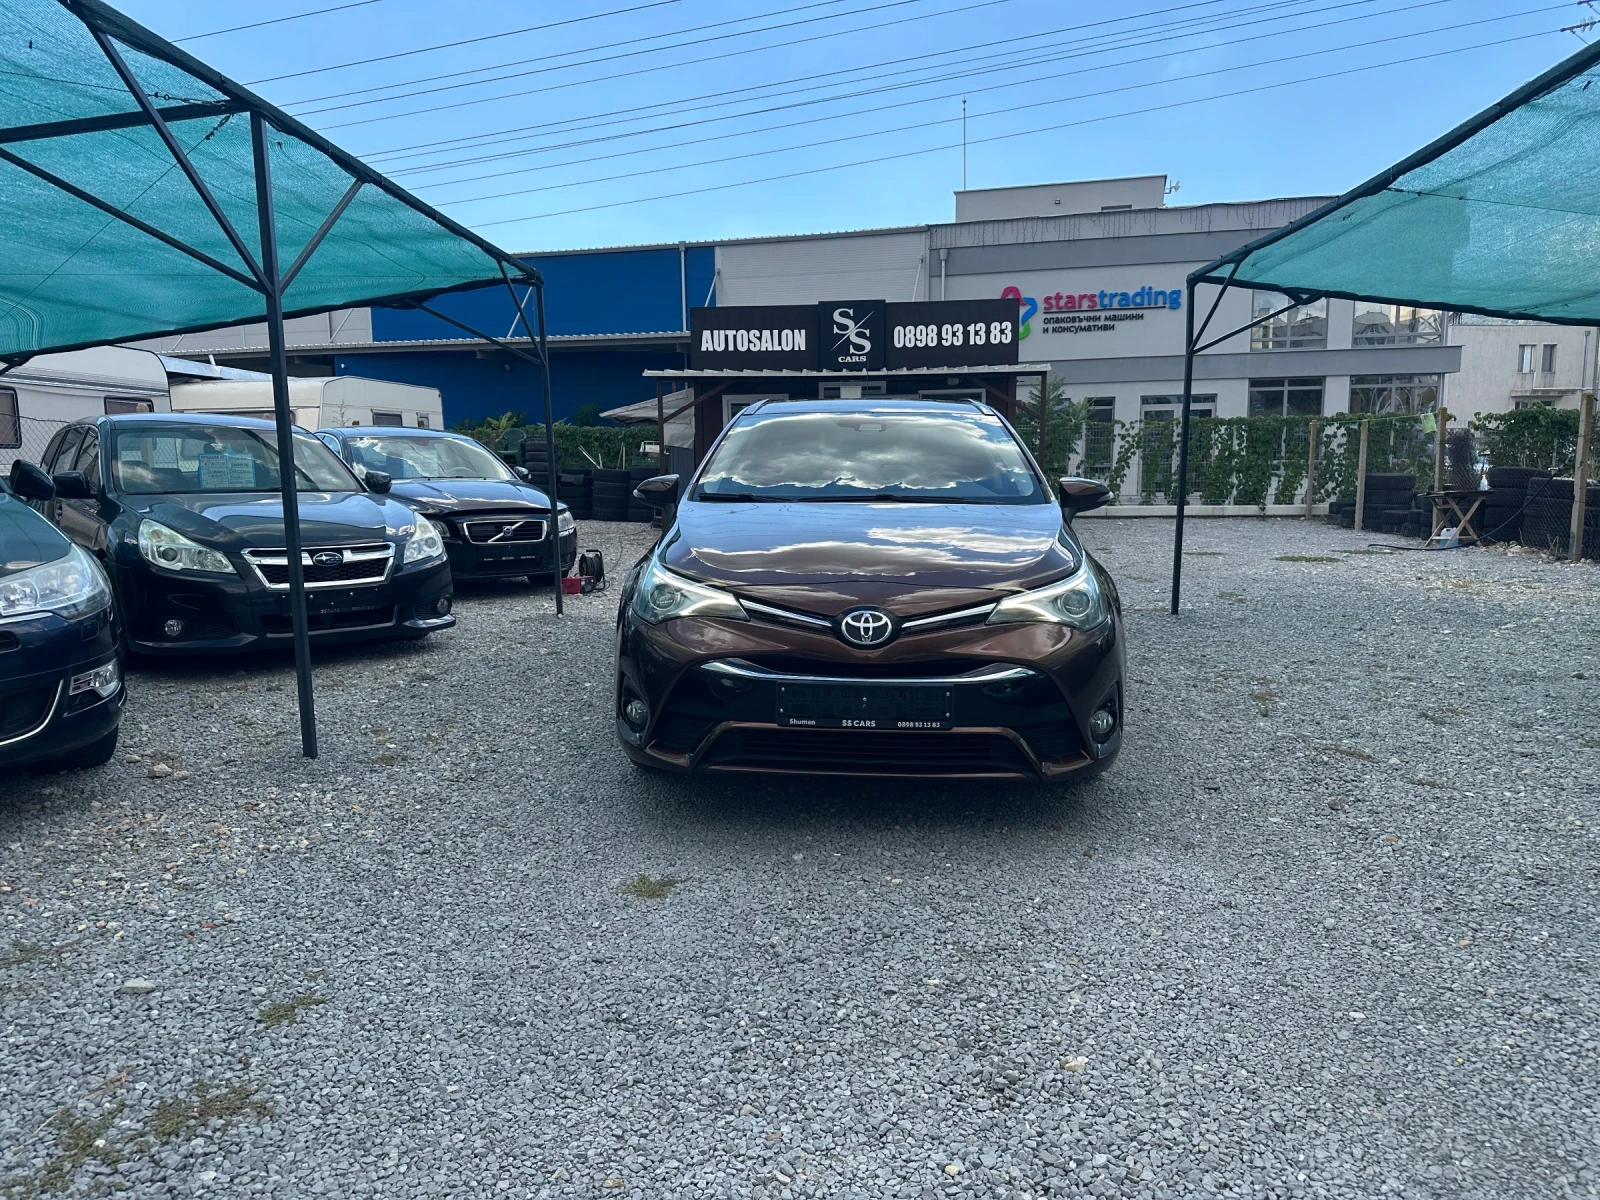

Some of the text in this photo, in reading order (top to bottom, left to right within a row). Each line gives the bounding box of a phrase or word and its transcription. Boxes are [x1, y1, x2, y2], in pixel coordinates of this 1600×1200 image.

[1043, 286, 1181, 309] starstrading
[1043, 313, 1144, 325] опаковъчни машини
[893, 321, 1012, 348] 0898 93 13 83
[1051, 324, 1115, 334] консумативи
[701, 329, 806, 351] AUTOSALON
[789, 718, 816, 726] Shumen
